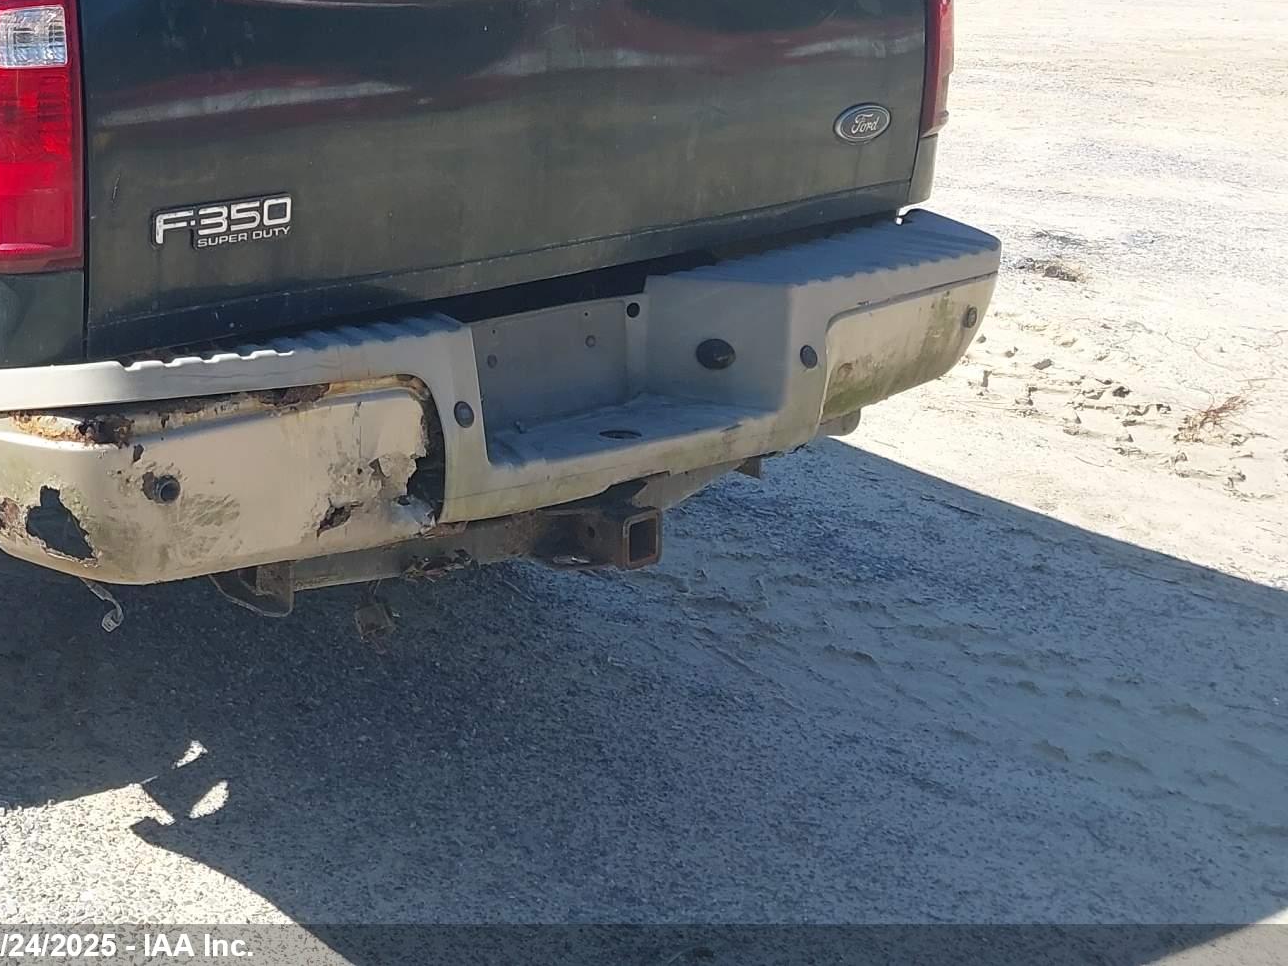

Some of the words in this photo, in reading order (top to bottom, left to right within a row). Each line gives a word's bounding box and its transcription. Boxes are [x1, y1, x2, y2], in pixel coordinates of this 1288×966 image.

[851, 113, 880, 134] Ford
[197, 233, 248, 248] SUPER
[252, 225, 291, 240] DUTY
